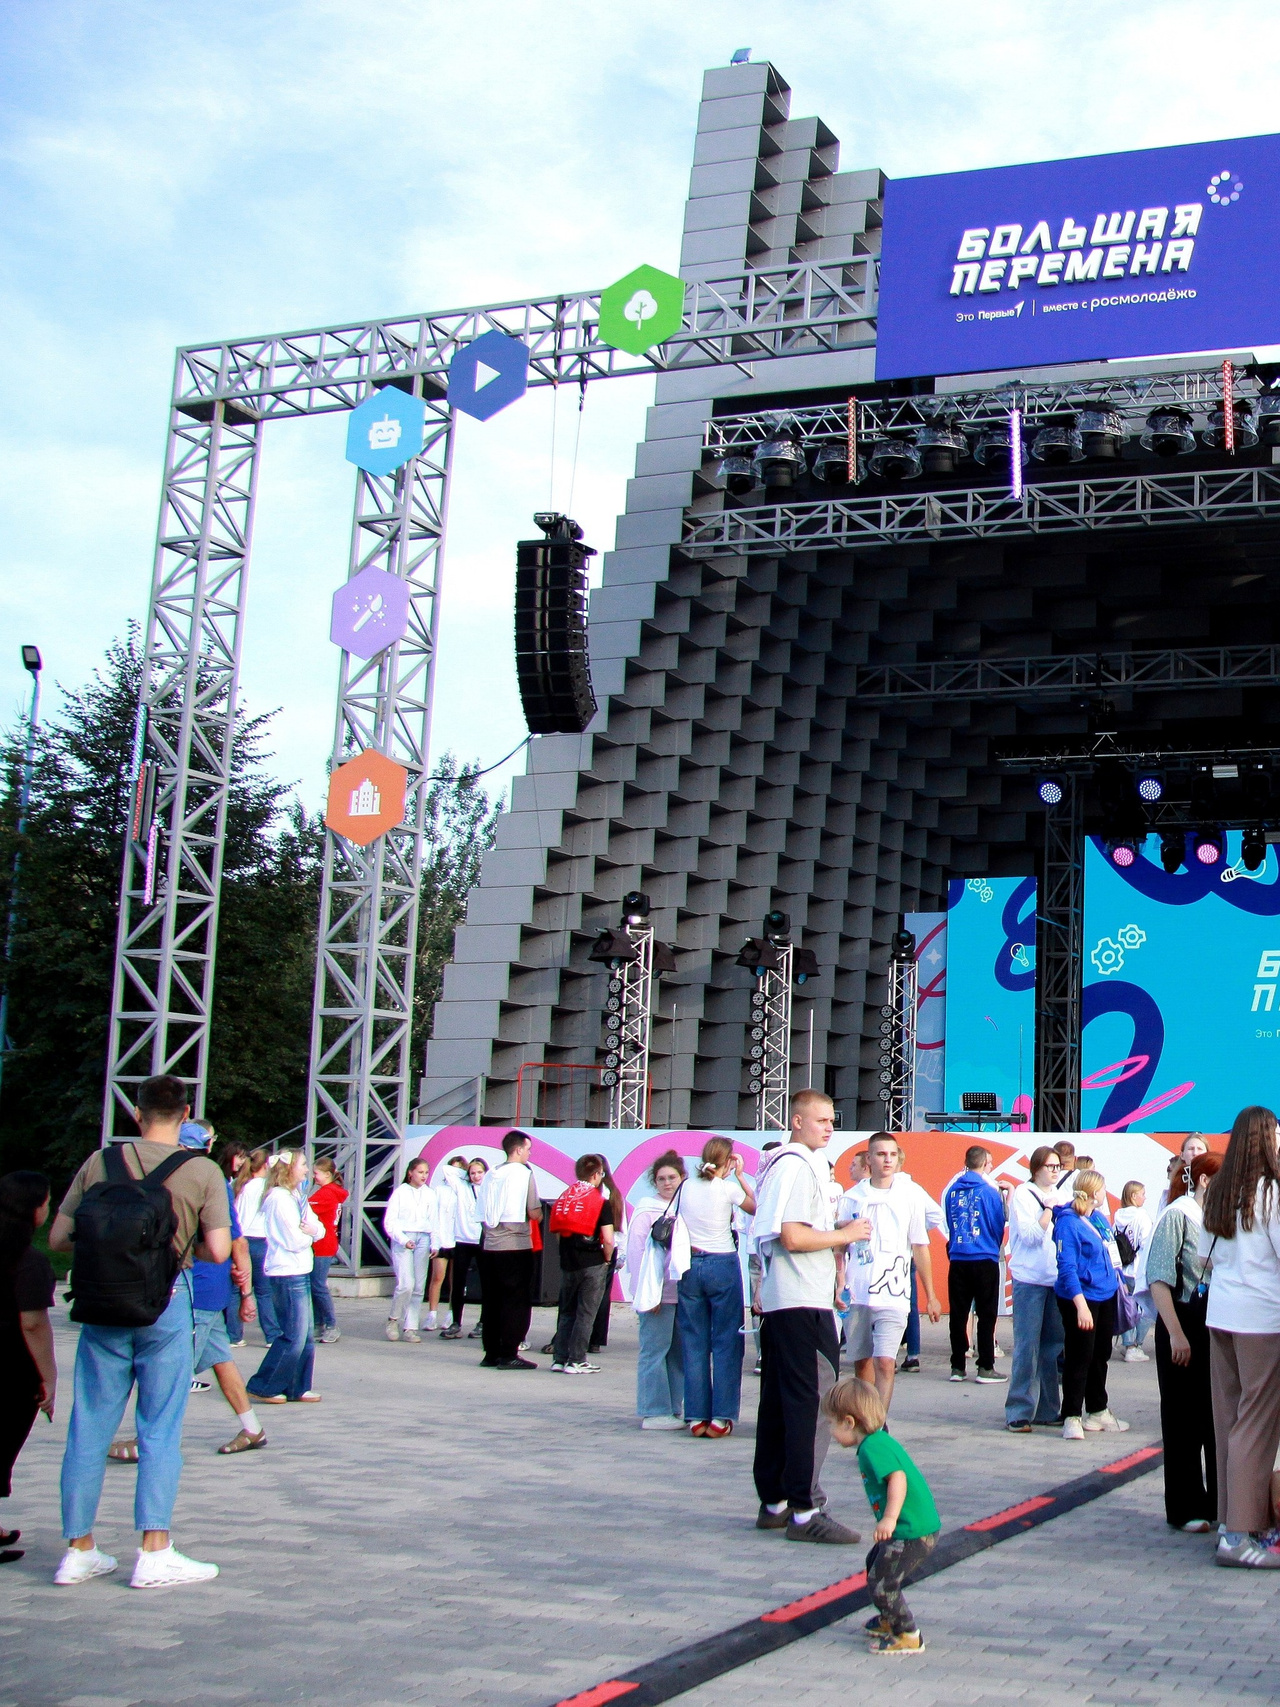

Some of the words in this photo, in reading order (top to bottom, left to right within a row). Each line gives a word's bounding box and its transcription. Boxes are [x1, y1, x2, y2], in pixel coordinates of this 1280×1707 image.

[957, 202, 1204, 262] БОЛЬШАЯ
[950, 239, 1196, 297] ПЕРЕМЕНА
[955, 312, 975, 323] Это
[1042, 301, 1079, 313] вместе
[1081, 301, 1088, 309] с
[1090, 288, 1198, 312] росмолодёжь
[1255, 1029, 1273, 1039] Это
